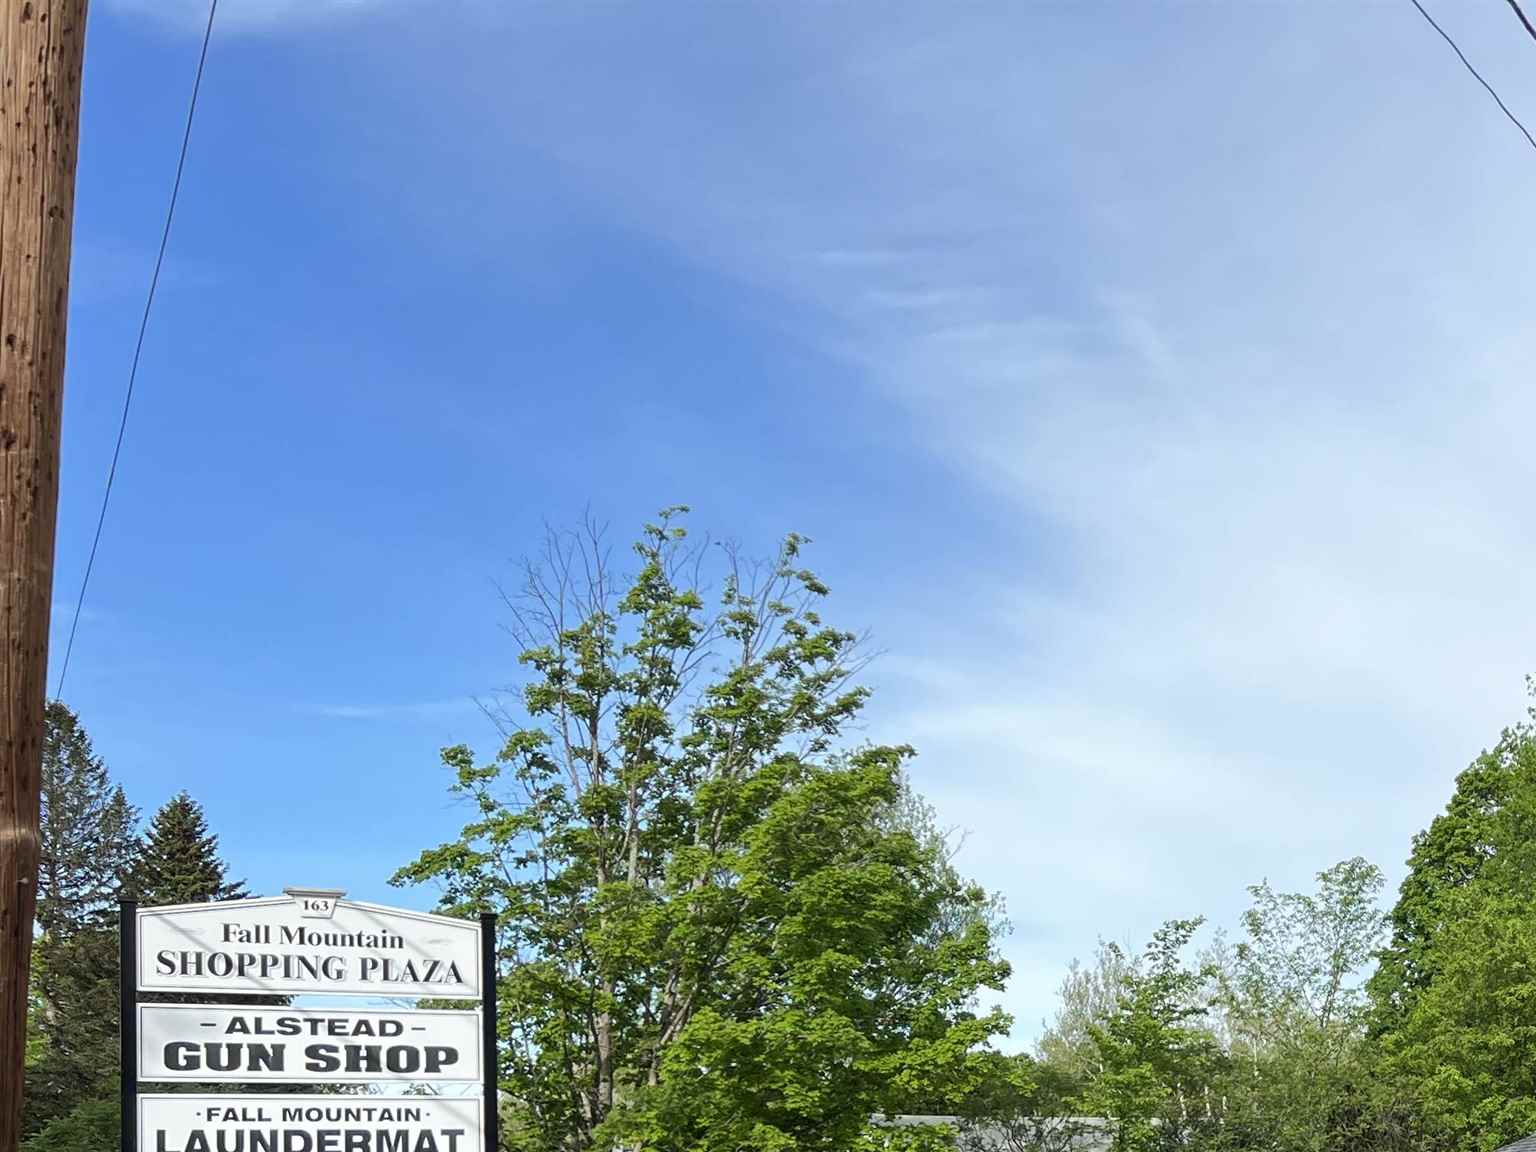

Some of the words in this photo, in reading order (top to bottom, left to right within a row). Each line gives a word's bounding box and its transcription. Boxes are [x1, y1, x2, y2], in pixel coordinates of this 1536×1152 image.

[302, 899, 330, 912] 163
[222, 923, 271, 945] Fall
[280, 925, 404, 949] Mountain
[156, 950, 344, 981] SHOPPING
[359, 956, 464, 984] PLAZA
[224, 1016, 404, 1037] ALSTEAD
[163, 1042, 286, 1072] GUN
[304, 1044, 460, 1074] SHOP
[206, 1107, 272, 1122] FALL
[282, 1107, 422, 1122] MOUNTAIN
